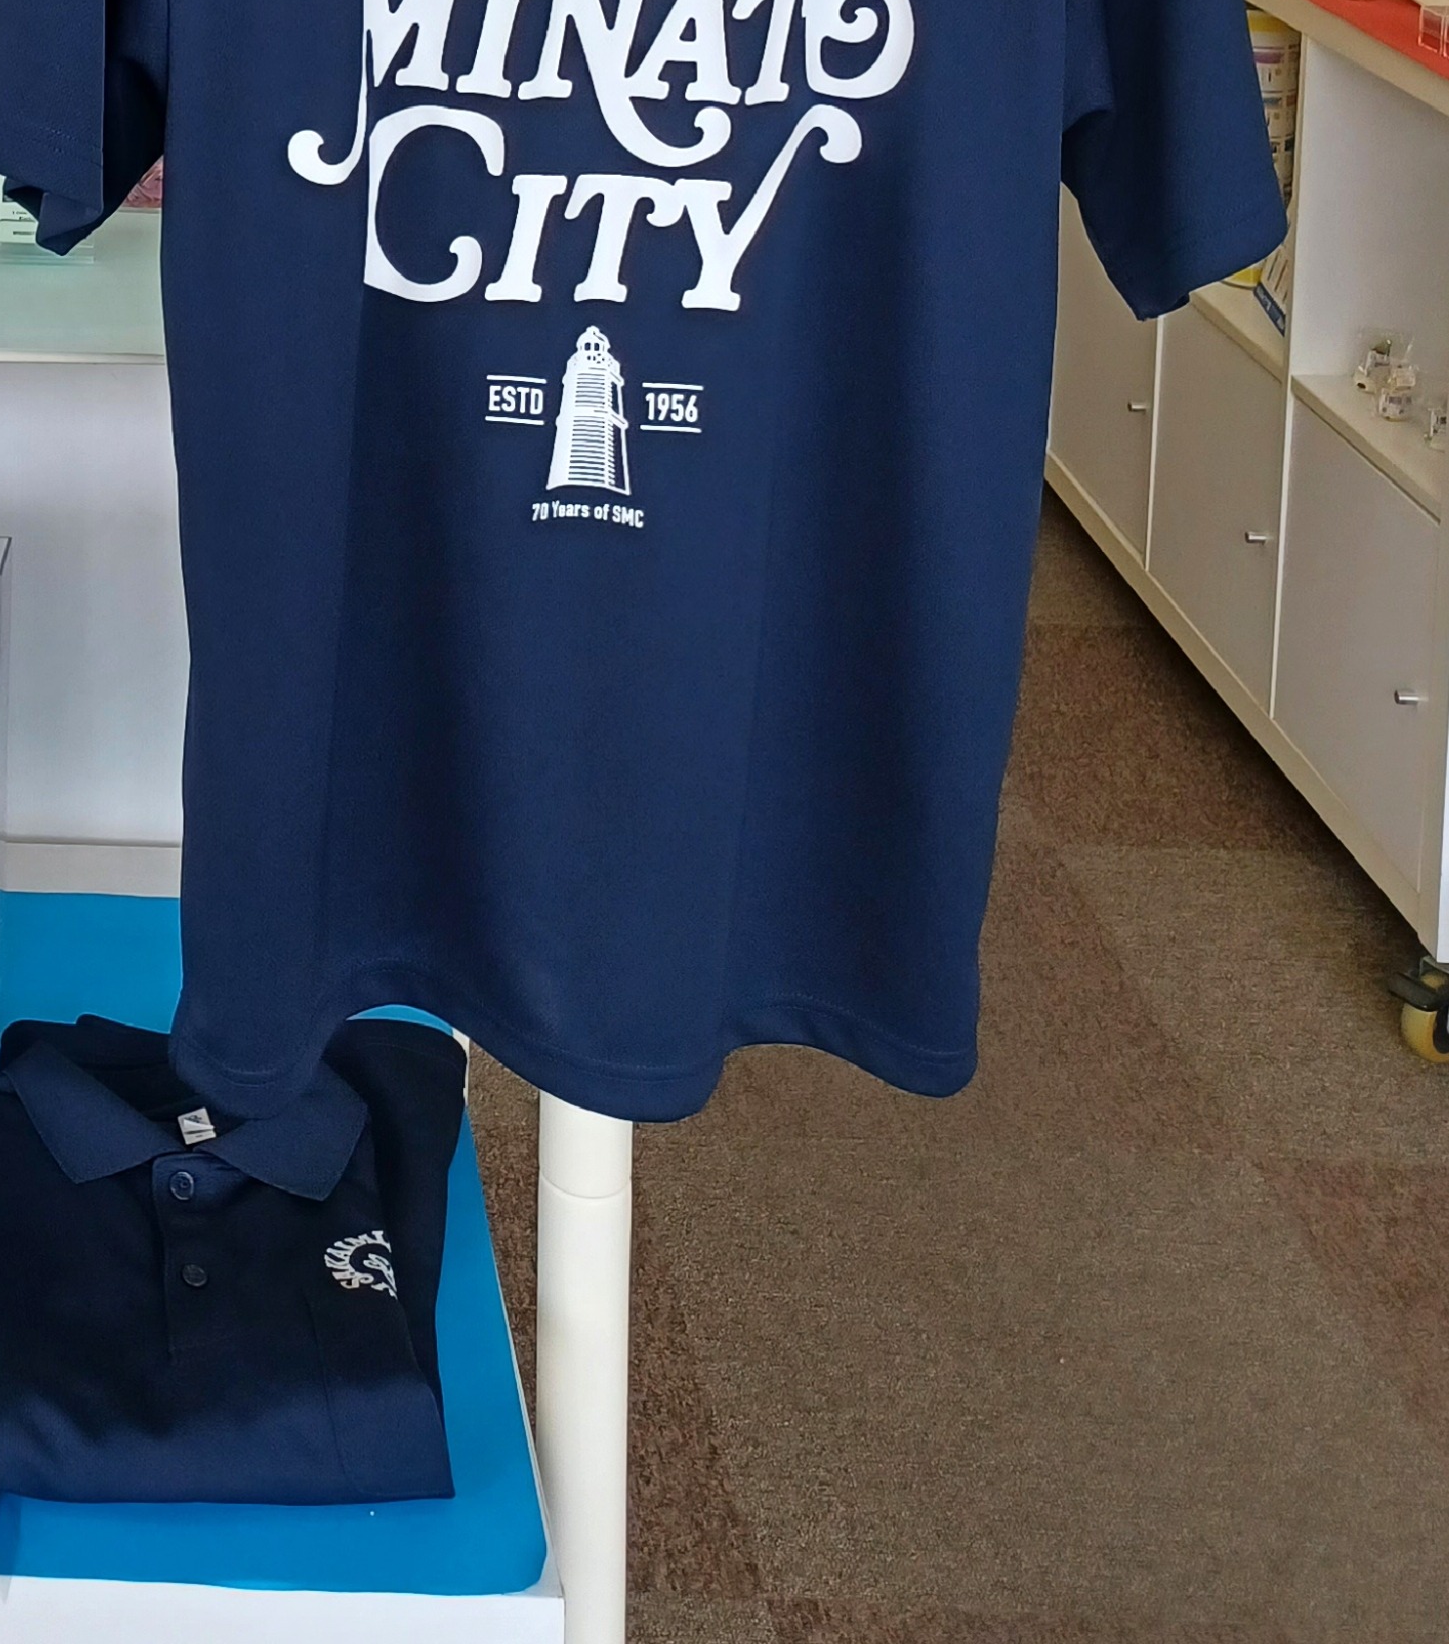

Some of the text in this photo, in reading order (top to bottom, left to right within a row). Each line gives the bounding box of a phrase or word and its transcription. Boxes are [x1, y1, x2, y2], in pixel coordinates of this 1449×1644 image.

[363, 104, 862, 310] CITY
[488, 385, 699, 423] ESTD 1956
[531, 500, 645, 528] 70 Years of SMC
